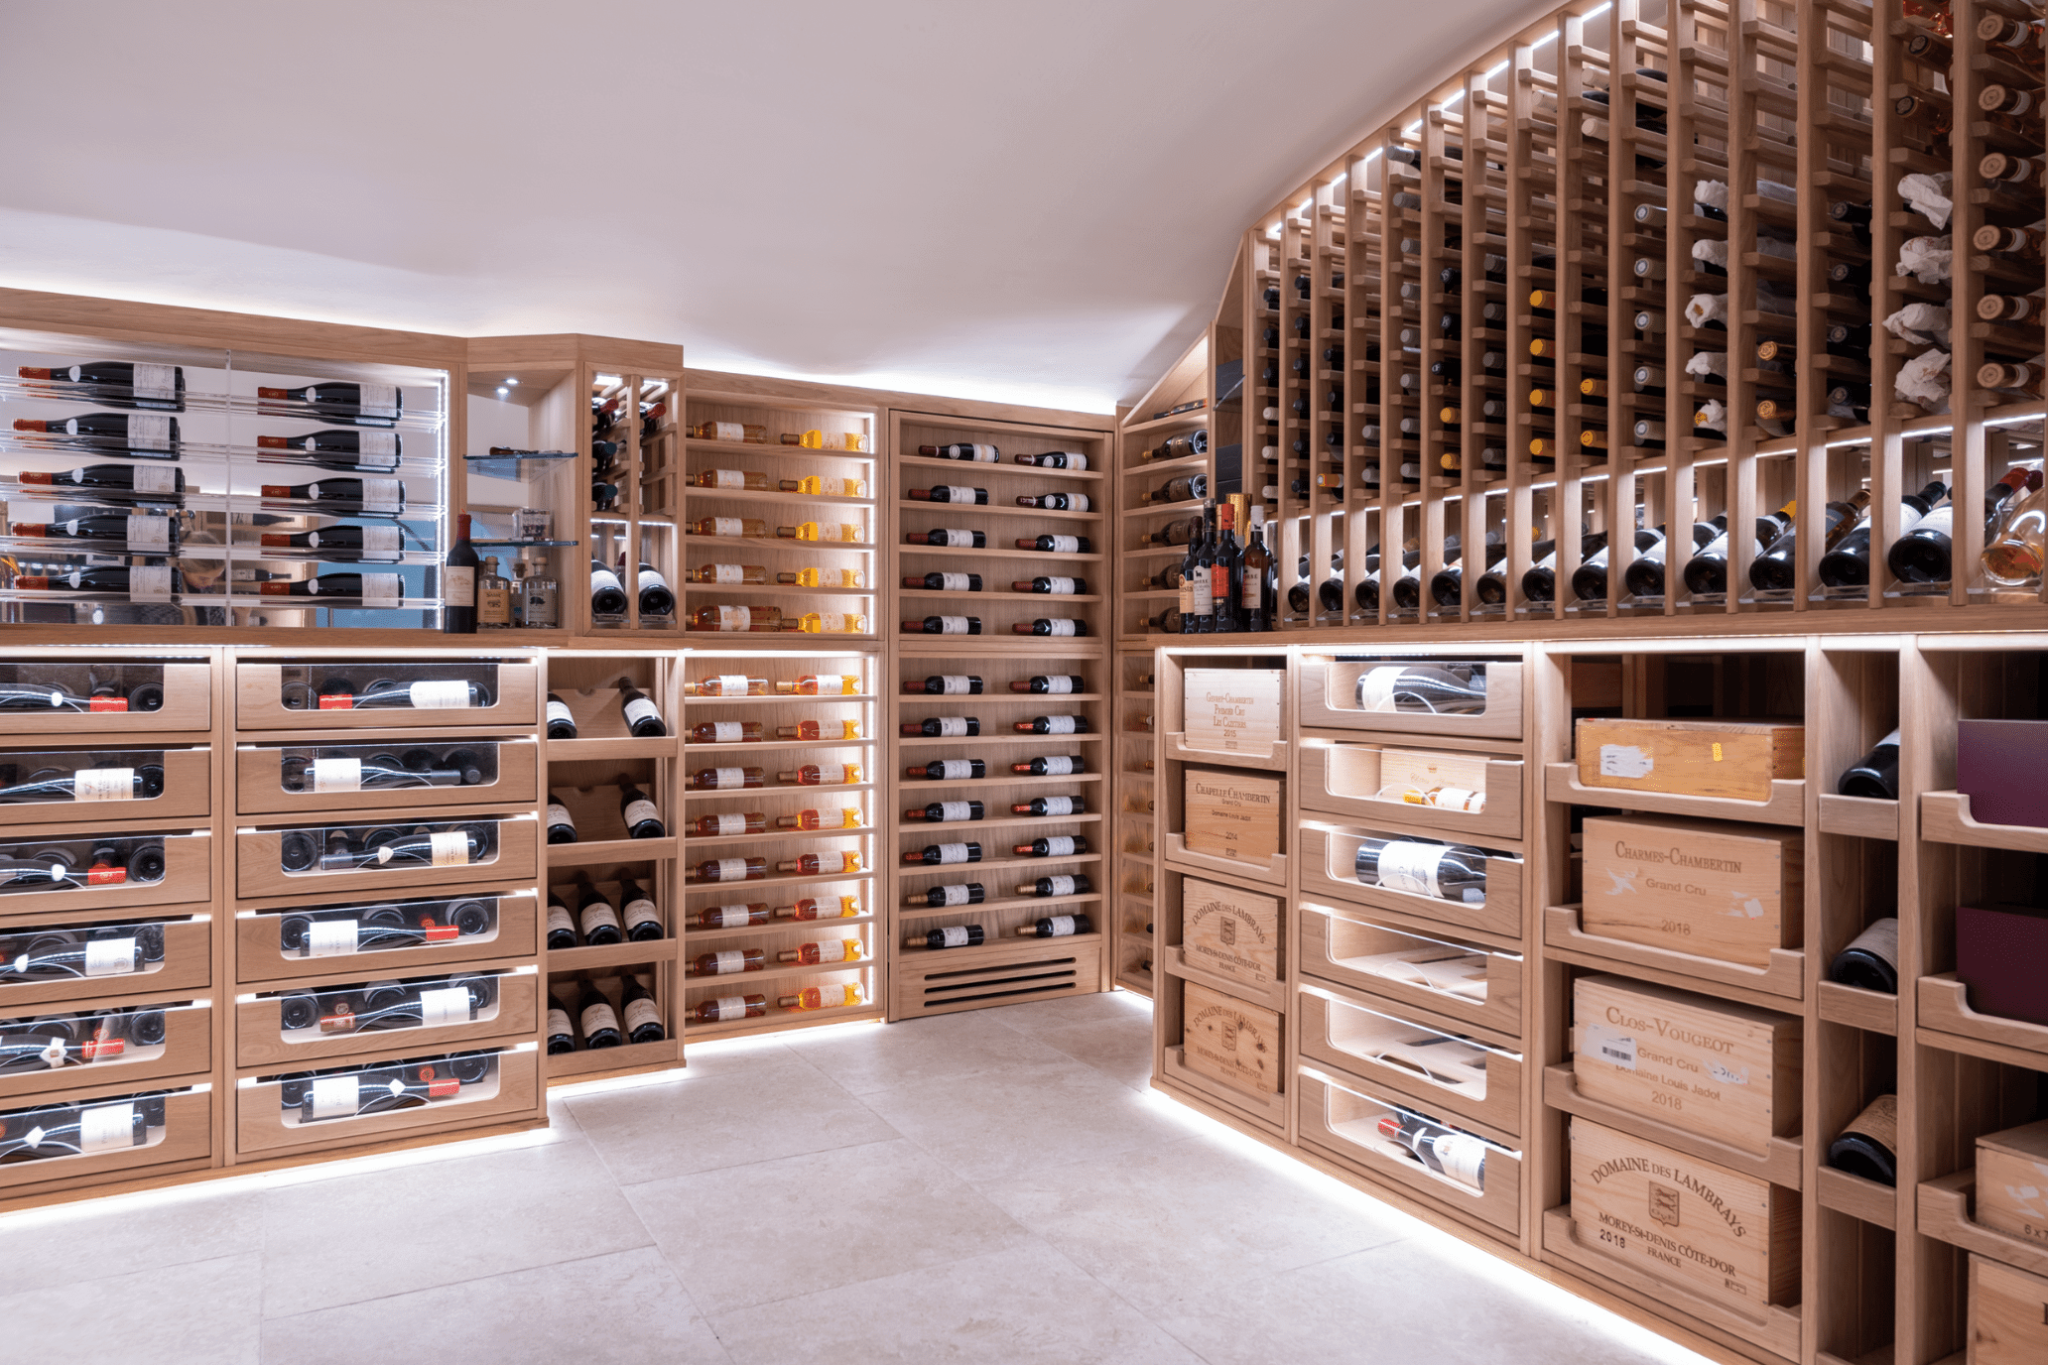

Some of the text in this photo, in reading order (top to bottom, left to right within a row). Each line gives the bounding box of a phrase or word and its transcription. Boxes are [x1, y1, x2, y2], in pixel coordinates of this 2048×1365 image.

[1196, 783, 1270, 804] CHAPELLE CHAMBERTIN
[1615, 840, 1742, 874] CHARMES-CHAMBERTIN
[1646, 878, 1706, 896] Grand Cru
[1192, 902, 1221, 925] DOMAINE
[1232, 904, 1266, 944] LAMBRAYS
[1662, 919, 1692, 936] 2018
[1606, 1006, 1734, 1054] CLOS-VOUGEOT
[1637, 1047, 1698, 1073] Grand Cru
[1661, 1074, 1688, 1091] Louis
[1691, 1084, 1721, 1101] Jadot
[1652, 1090, 1682, 1110] 2018
[1590, 1157, 1650, 1185] DOMAINE
[1651, 1163, 1671, 1178] DES
[1674, 1168, 1747, 1238] LAMBRAYS
[1600, 1228, 1626, 1249] 2018
[2024, 1224, 2031, 1235] 6
[1647, 1246, 1682, 1268] FRANCE
